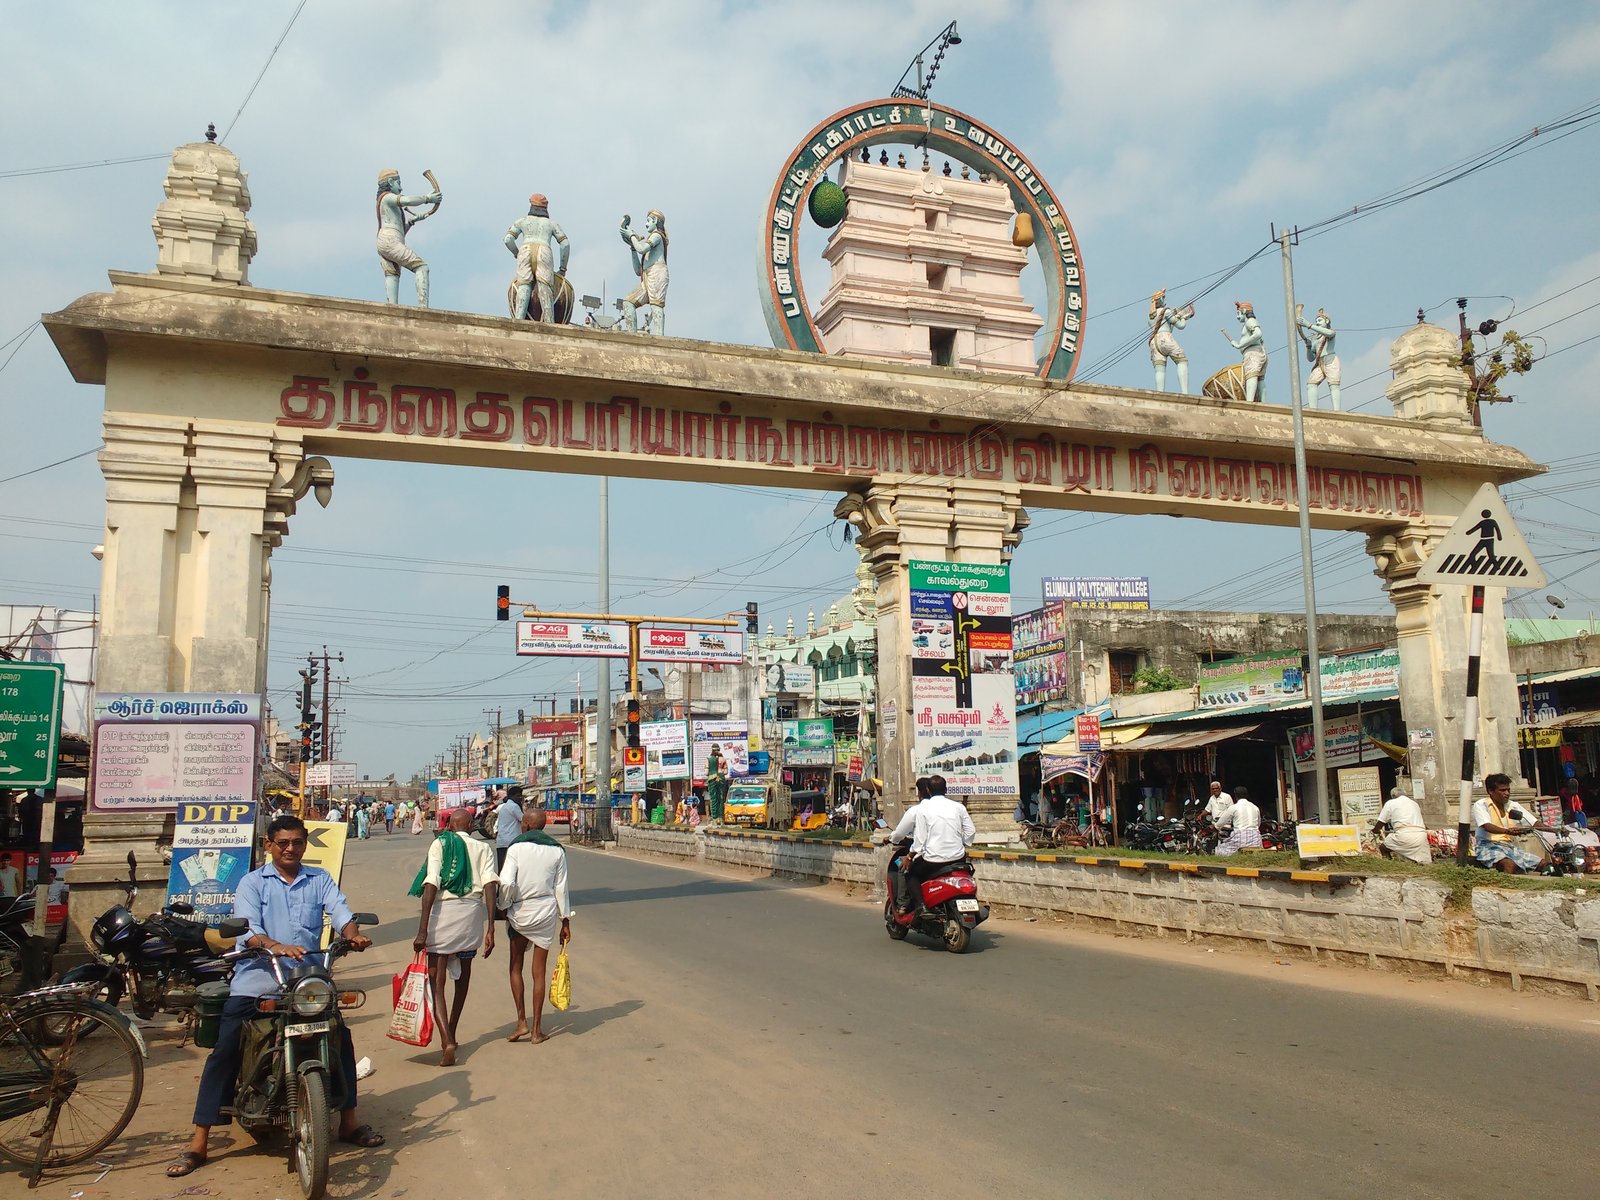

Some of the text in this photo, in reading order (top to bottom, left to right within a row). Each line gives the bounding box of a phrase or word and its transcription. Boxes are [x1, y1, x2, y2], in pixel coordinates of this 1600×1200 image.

[811, 106, 902, 163] நகராட்சி
[944, 117, 1082, 352] உழைப்பே உயர்வு தரும்
[275, 366, 513, 443] தந்தை
[522, 396, 740, 462] பெரியார்
[1012, 432, 1114, 495] விழா
[913, 562, 1006, 577] பண்ருட்டி போக்குவரத்து
[926, 574, 988, 590] காவல்துறை
[1045, 582, 1148, 597] ELUMALAI POLYTECHNIC COLLEGE
[969, 593, 1009, 604] சென்னை
[975, 604, 1005, 616] கடலூர்
[547, 625, 567, 633] AGL
[582, 643, 628, 651] செராமிக்ஸ்
[917, 647, 946, 658] சேலம்
[700, 650, 742, 658] செராமிக்ஸ்
[2, 688, 19, 699] 178
[160, 698, 249, 716] ஜெராக்ஸ்
[39, 714, 49, 723] 14
[102, 731, 118, 741] DTP
[34, 750, 46, 758] 48
[183, 804, 250, 823] DTP
[191, 825, 238, 836] இங்கு டைப்
[177, 836, 248, 846] அடித்து தரப்படும்
